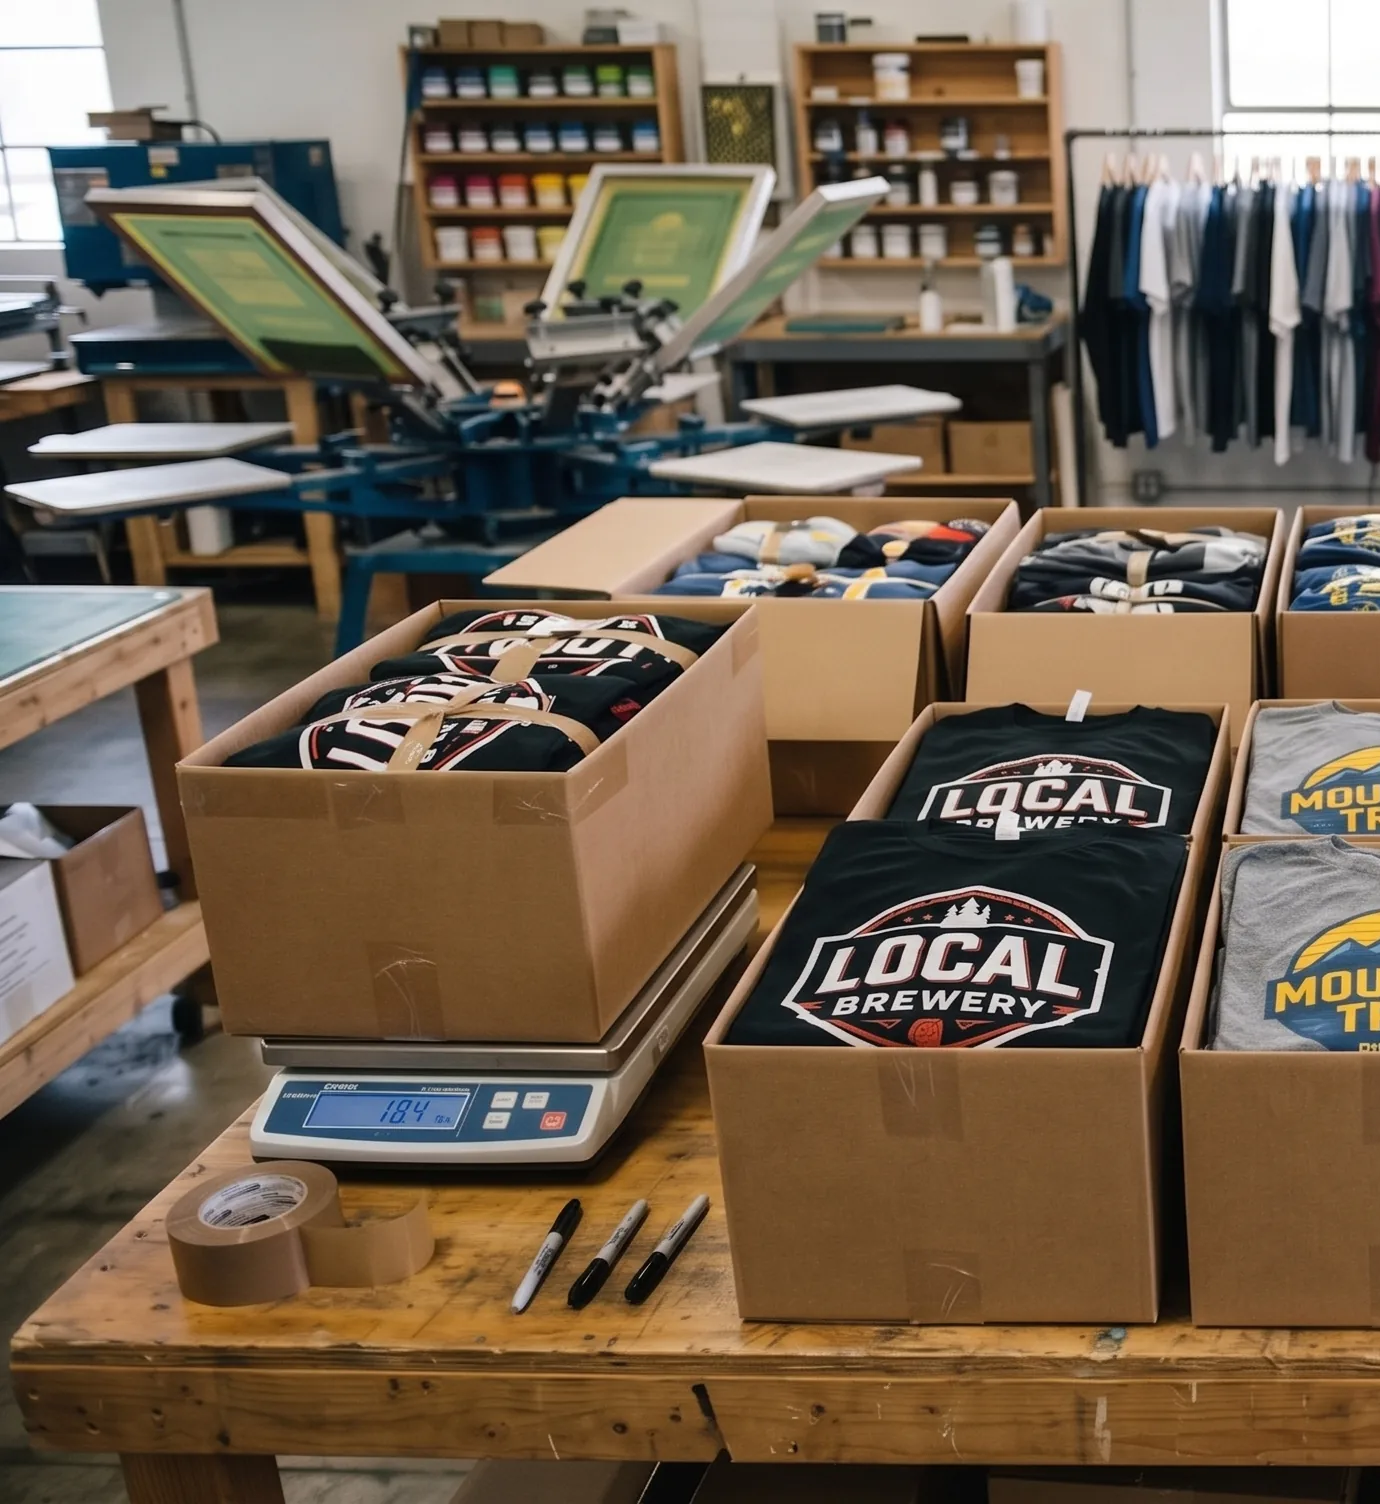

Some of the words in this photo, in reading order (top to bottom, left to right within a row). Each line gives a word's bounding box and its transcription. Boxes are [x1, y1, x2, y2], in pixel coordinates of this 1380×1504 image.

[939, 778, 1149, 820] LOCAL
[814, 932, 1083, 1000] LOCAL
[831, 989, 1047, 1019] BREWERY
[379, 1099, 431, 1124] 18.4
